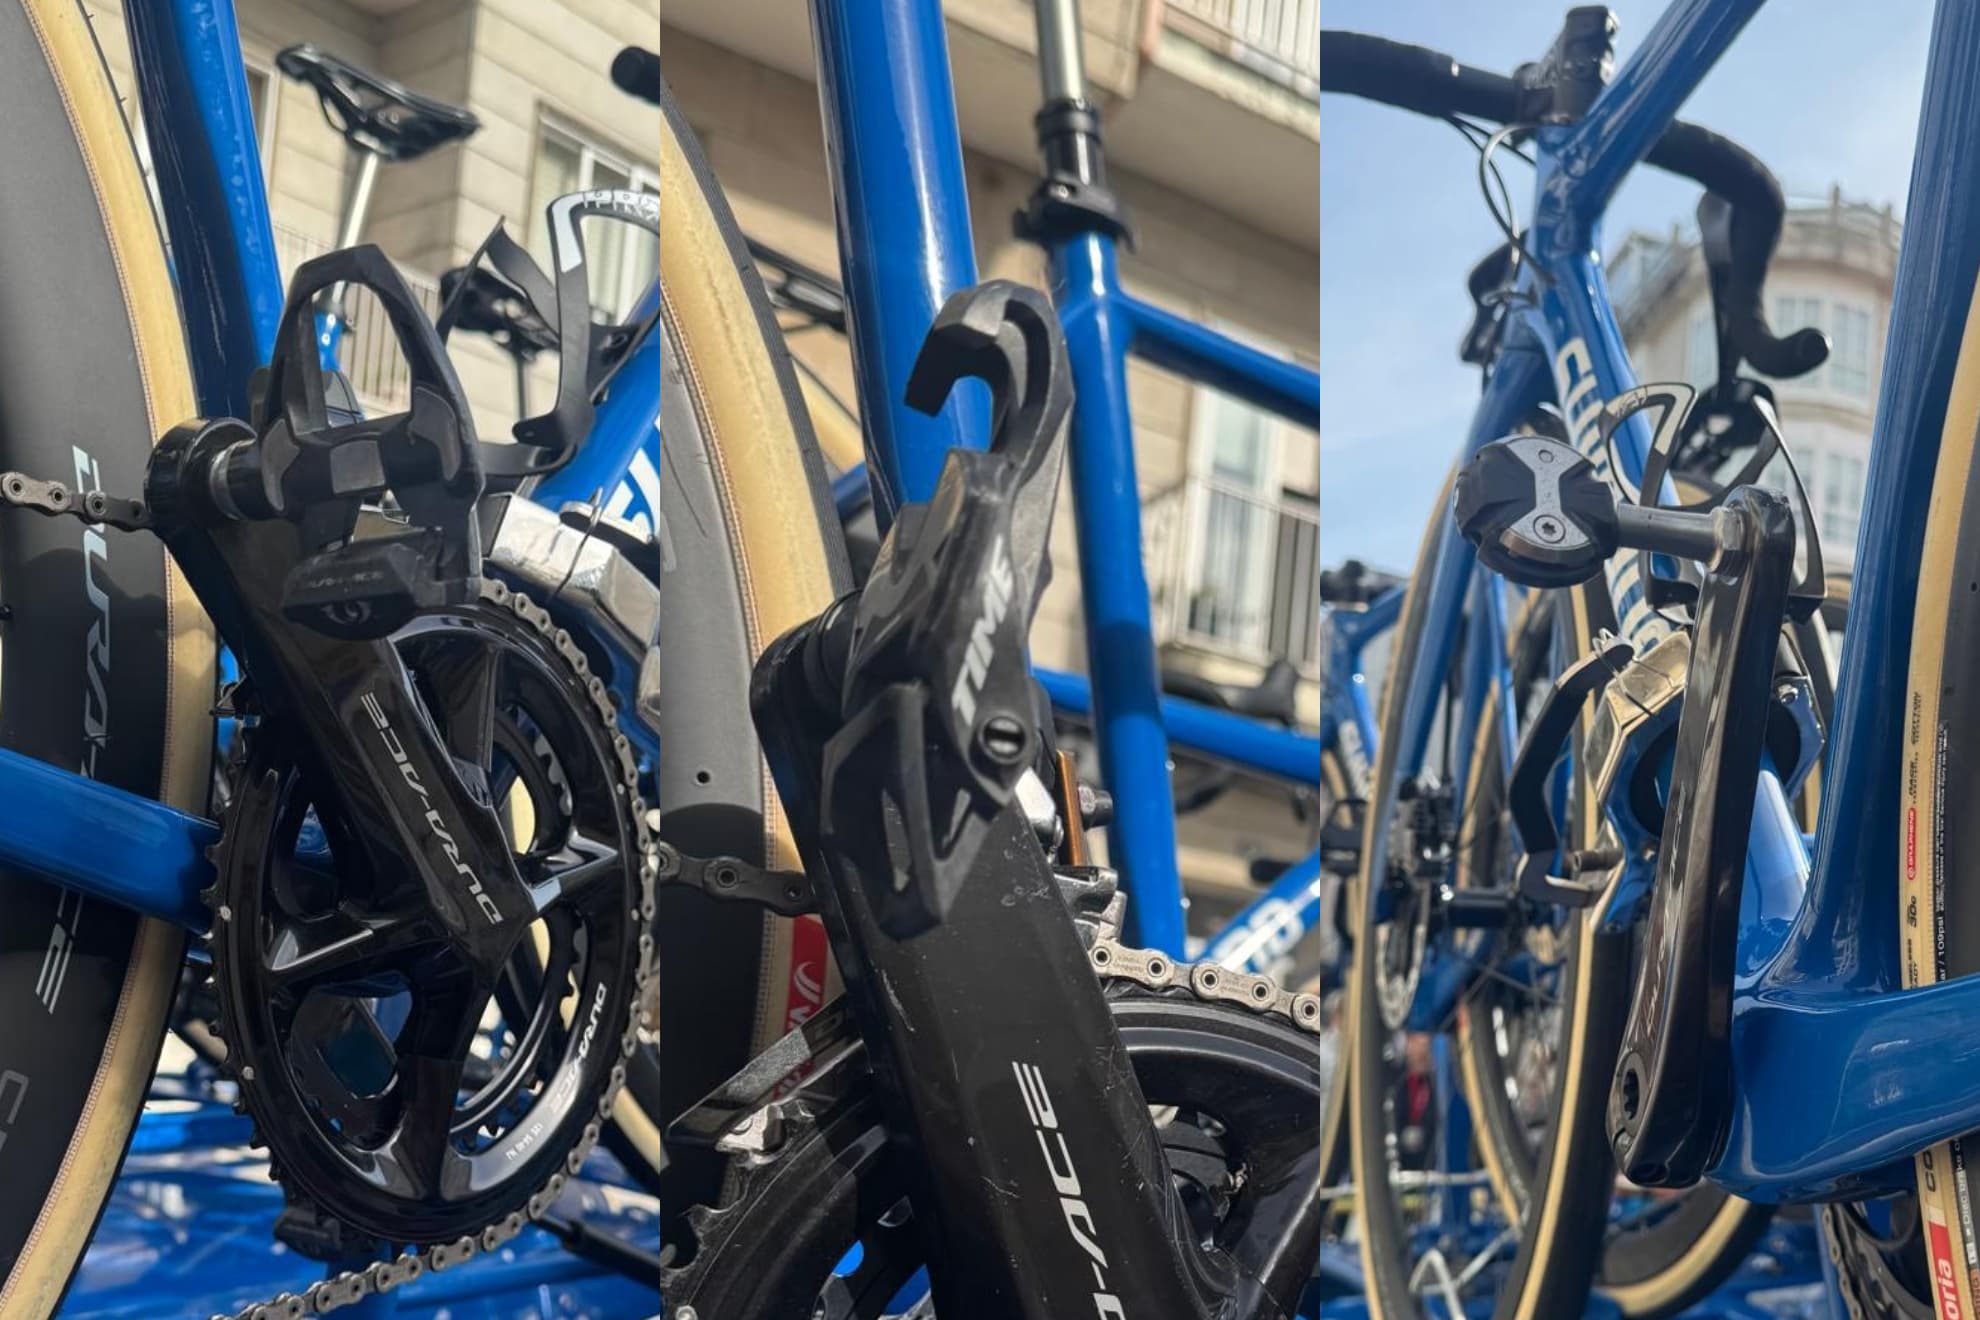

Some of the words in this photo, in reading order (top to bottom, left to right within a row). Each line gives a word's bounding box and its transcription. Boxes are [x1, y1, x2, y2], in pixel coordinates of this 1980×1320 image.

[952, 534, 1014, 726] TIME
[361, 692, 503, 924] DURA-ACE
[1937, 916, 1945, 956] 109psi
[550, 982, 608, 1115] DURA-ACE
